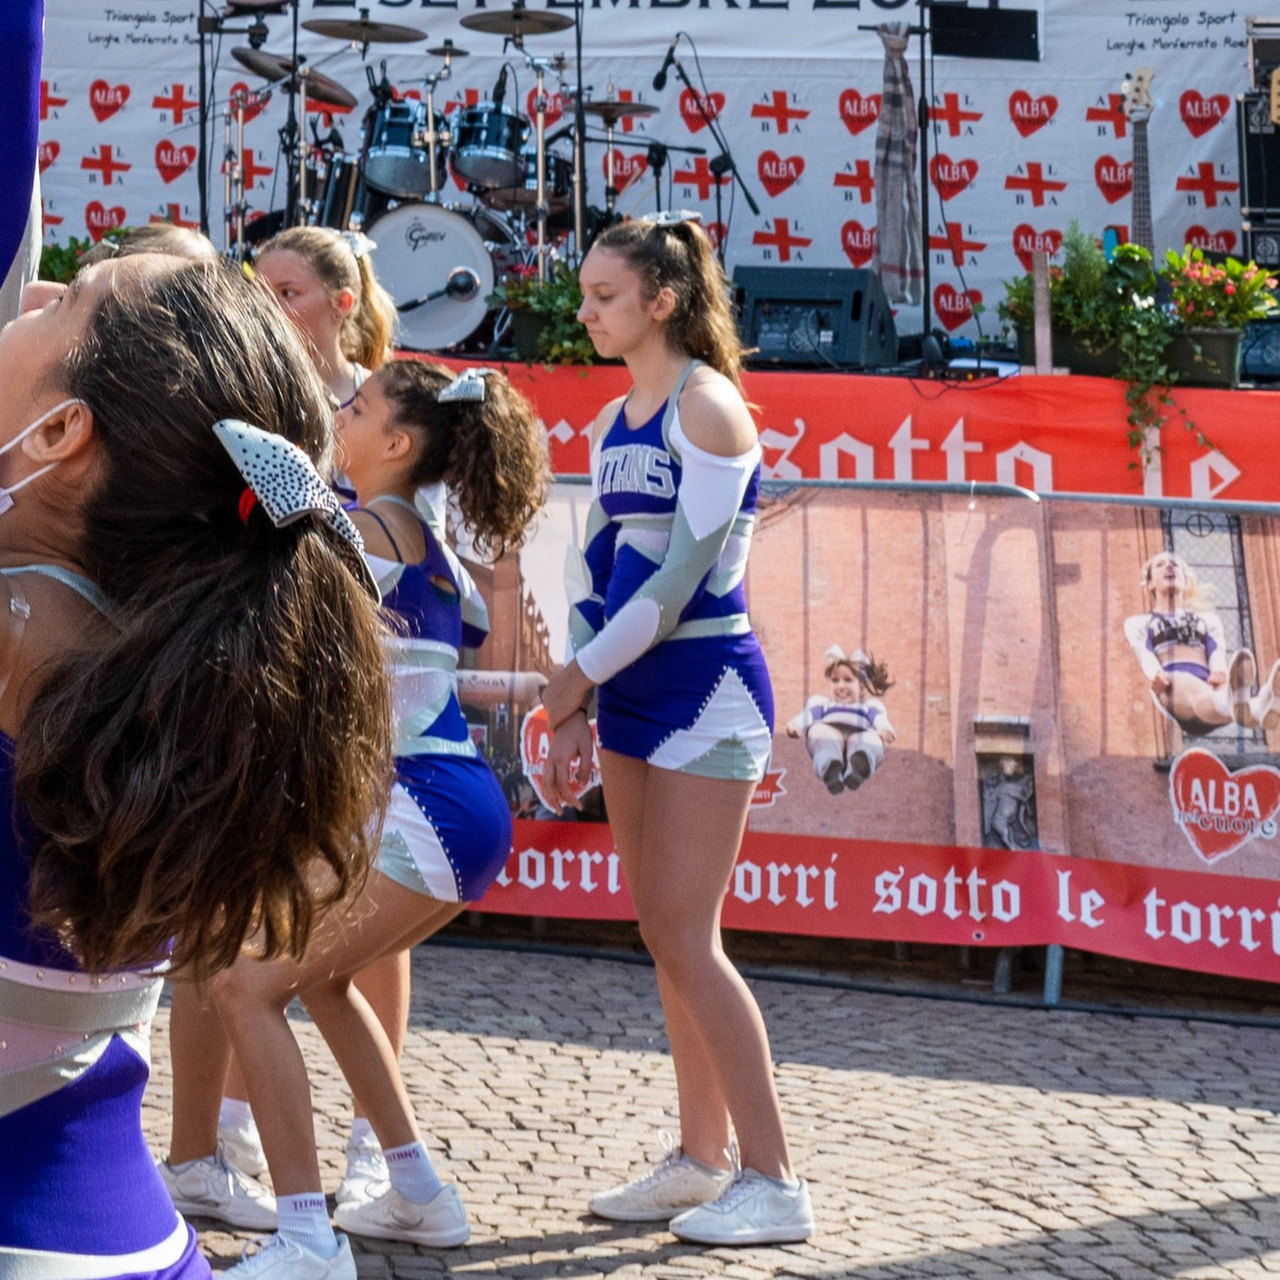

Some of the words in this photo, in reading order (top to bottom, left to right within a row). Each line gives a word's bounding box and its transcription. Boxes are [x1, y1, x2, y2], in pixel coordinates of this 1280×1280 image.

[162, 11, 195, 27] Sport
[1126, 13, 1190, 33] Triangolo
[1197, 10, 1237, 29] Sport
[1107, 39, 1146, 56] Langhe
[1152, 38, 1218, 50] Monferrato
[93, 89, 124, 105] ALBA
[844, 100, 878, 116] ALBA
[1014, 101, 1050, 118] ALBA
[1186, 100, 1222, 119] ALBA
[159, 150, 189, 166] ALBA
[763, 160, 797, 178] ALBA
[937, 164, 970, 182] ALBA
[90, 210, 122, 227] ALBA
[1019, 234, 1054, 252] ALBA
[938, 295, 973, 312] ALBA
[1190, 778, 1262, 819] ALBA
[733, 852, 839, 911] orri
[872, 865, 1021, 922] sotto
[1056, 869, 1106, 928] le
[291, 1199, 325, 1211] TITAN
